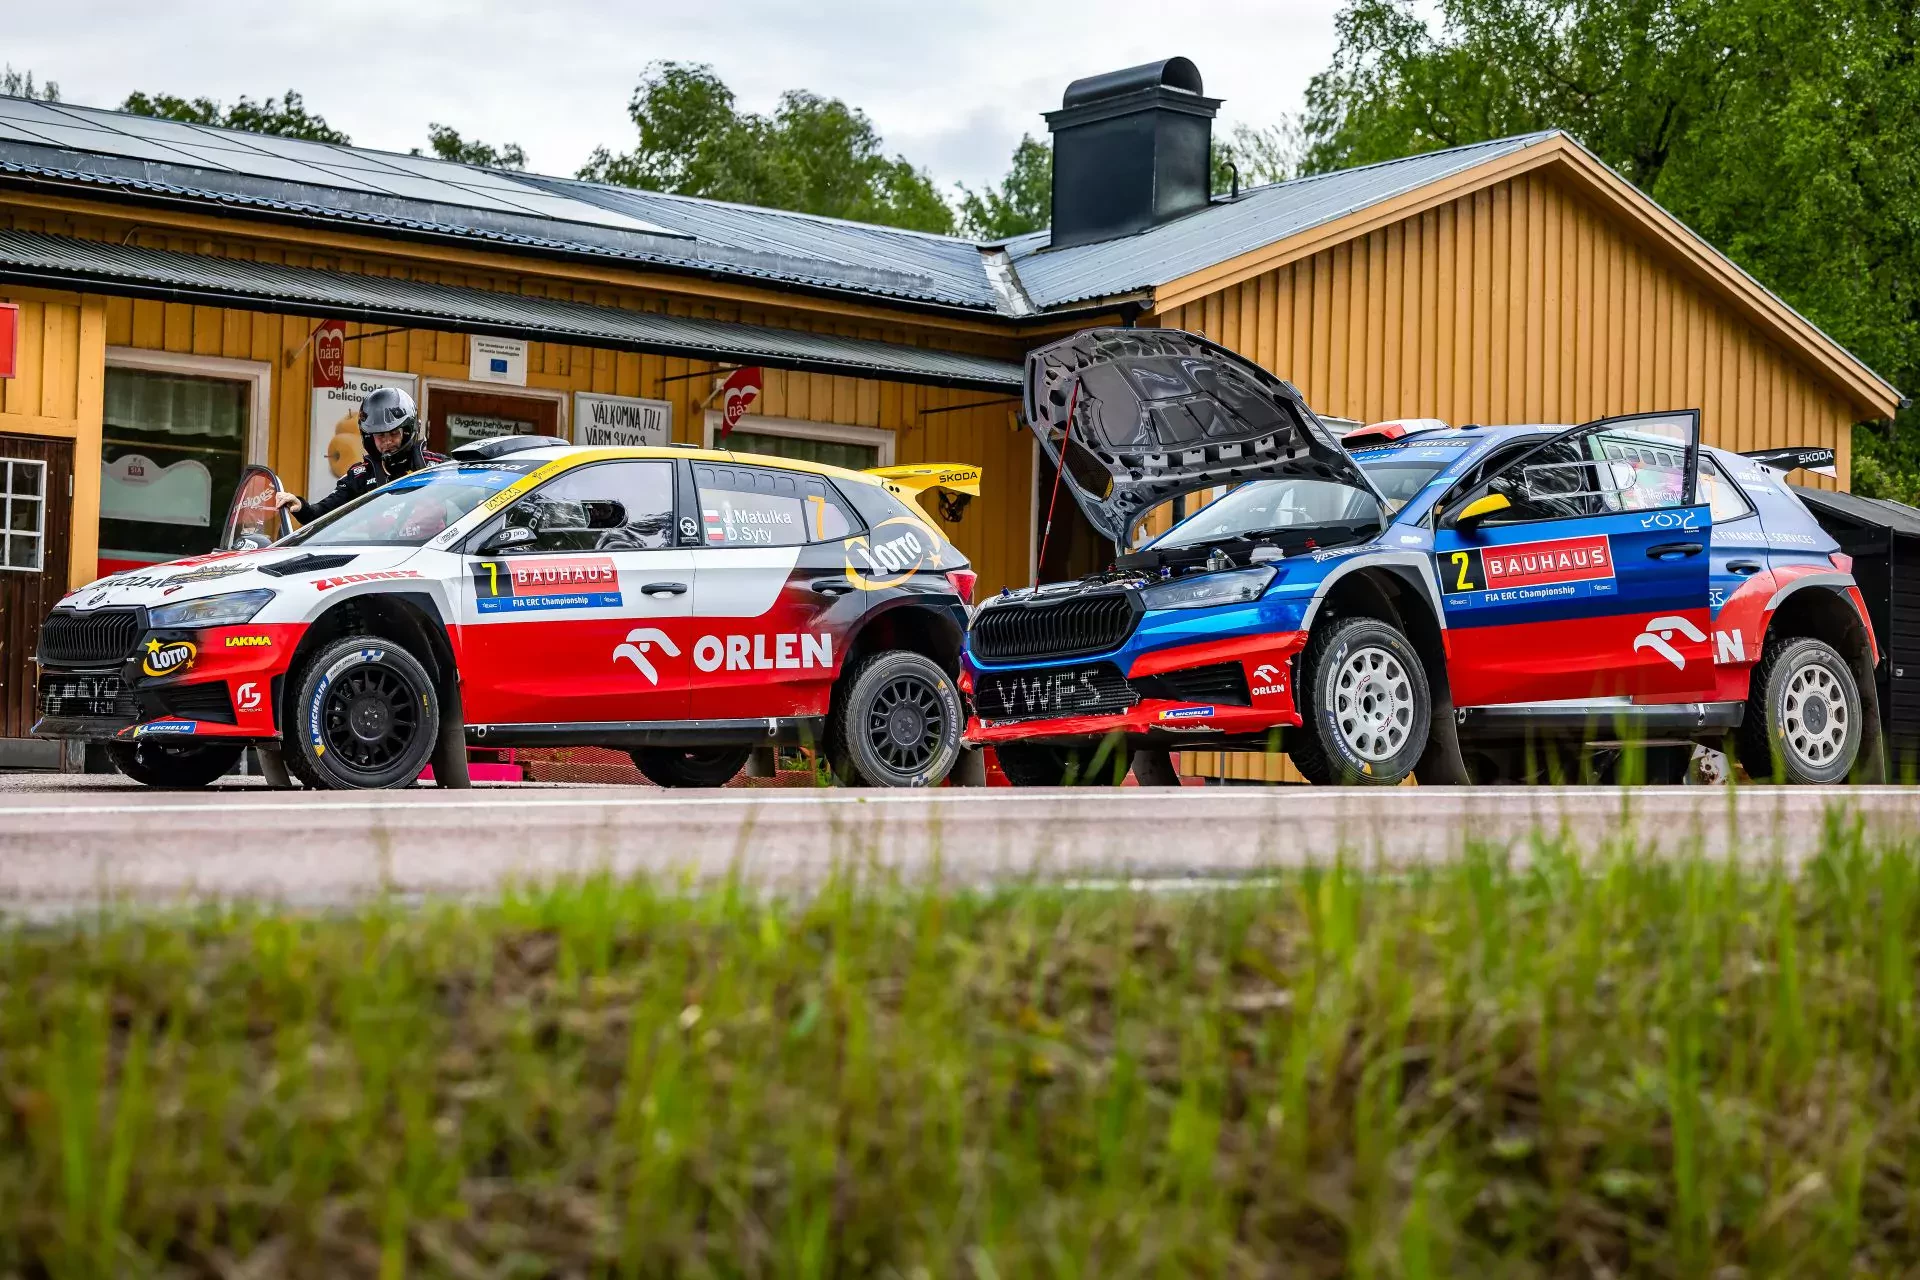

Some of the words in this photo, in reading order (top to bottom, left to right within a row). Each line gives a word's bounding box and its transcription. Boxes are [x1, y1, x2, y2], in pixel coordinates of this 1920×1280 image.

[320, 344, 340, 359] nära
[328, 361, 342, 380] dej
[327, 390, 366, 403] Delicio
[455, 417, 482, 429] Bygden
[483, 420, 513, 431] behöver
[591, 401, 641, 431] VÄLKOMNA
[644, 408, 661, 432] TILL
[468, 428, 498, 438] butiken!
[722, 508, 793, 525] J.Matulka
[808, 495, 825, 541] 7
[726, 526, 772, 543] D.Syty
[1720, 531, 1771, 542] FINANCIAL
[1772, 533, 1816, 545] SERVICES
[857, 531, 922, 577] LOTTO
[1451, 552, 1474, 590] 2
[1489, 549, 1605, 575] BAUHAUS
[481, 562, 498, 597] 7
[517, 565, 613, 584] BAUHAUS
[512, 599, 525, 607] FIA
[527, 598, 540, 607] ERC
[541, 596, 589, 606] Championship
[1485, 594, 1499, 603] FIA
[1501, 591, 1517, 601] ERC
[1519, 585, 1576, 599] Championship
[225, 636, 272, 647] LAKMA
[151, 646, 188, 669] LOTTO
[693, 633, 833, 673] ORLEN
[996, 668, 1101, 714] VWFS
[1252, 684, 1285, 696] ORLEN
[310, 680, 328, 735] MICHELIN
[147, 724, 191, 732] MICHELIN
[944, 695, 957, 747] MICHELIN
